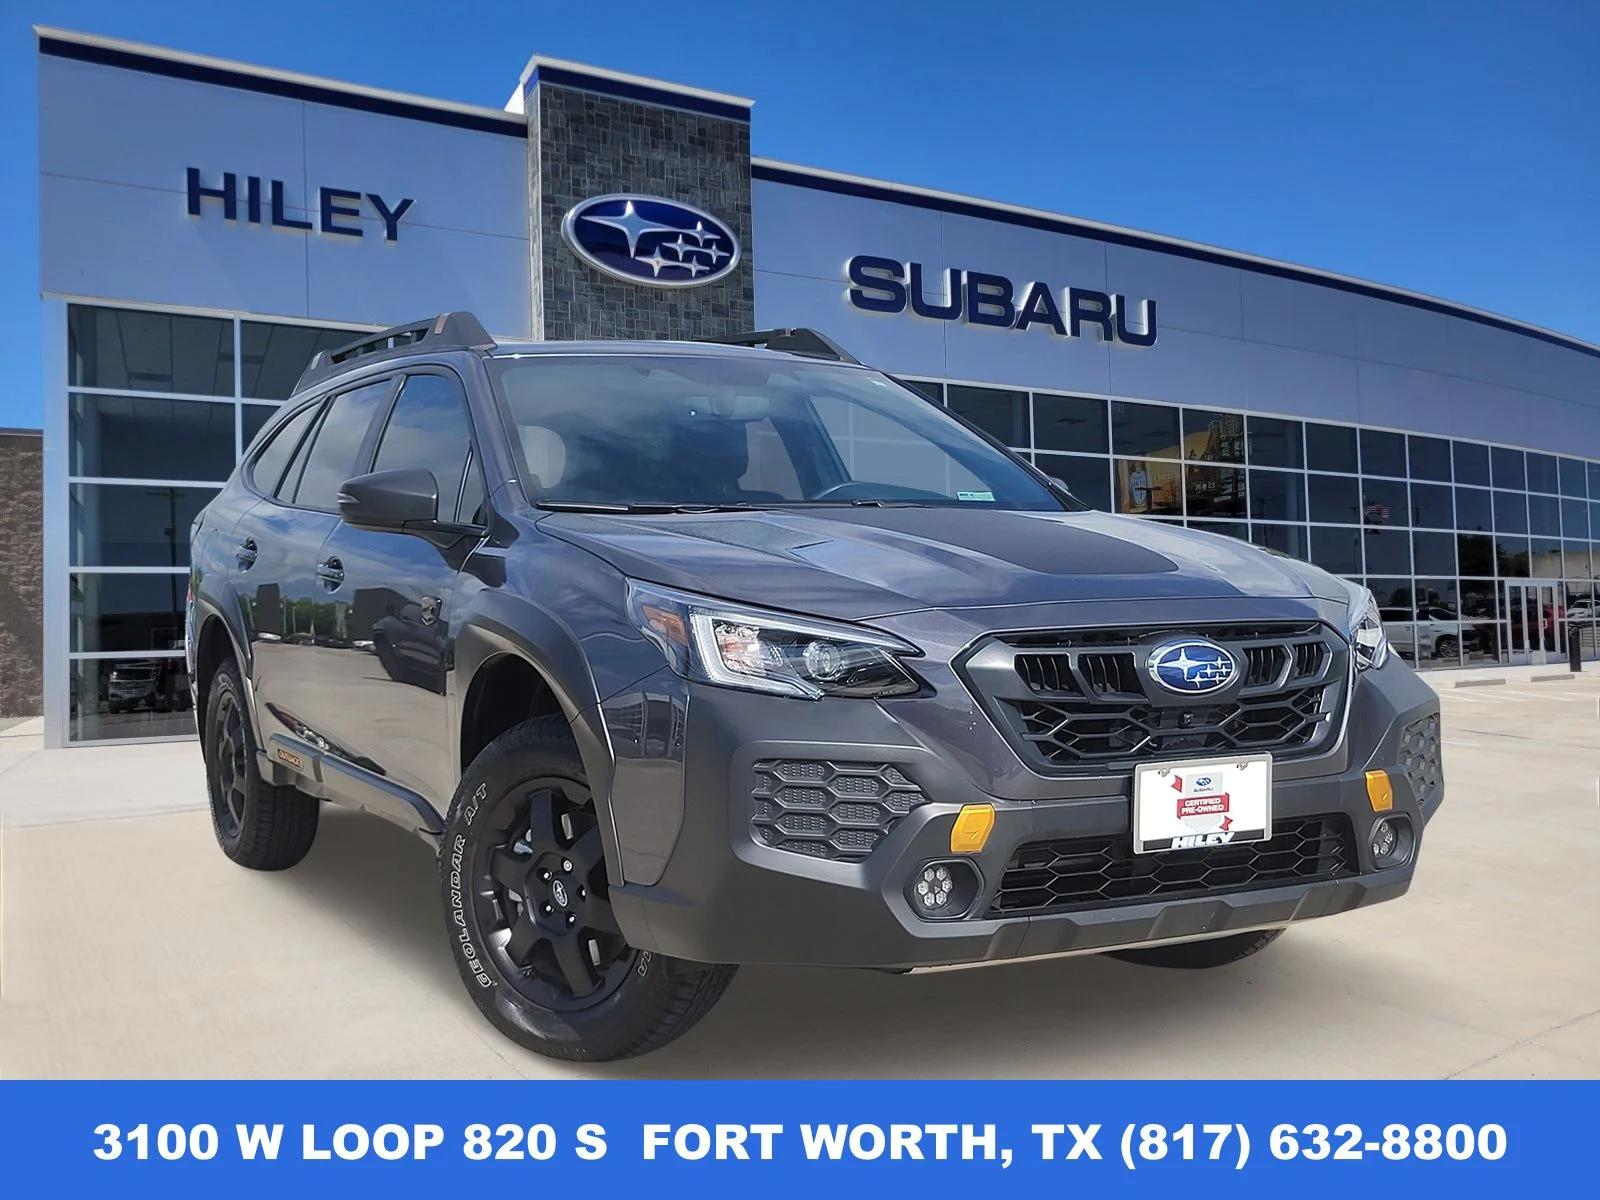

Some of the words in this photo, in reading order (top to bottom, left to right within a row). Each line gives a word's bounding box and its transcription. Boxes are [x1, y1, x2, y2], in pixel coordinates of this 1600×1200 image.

[186, 167, 416, 242] HILEY
[847, 254, 1158, 347] SUBARU
[463, 783, 488, 826] A/T
[1181, 804, 1225, 815] PRE-OWNED
[1184, 797, 1222, 807] CERTIFIED
[1171, 831, 1235, 849] HILEY
[450, 834, 492, 988] GEOLANDAR
